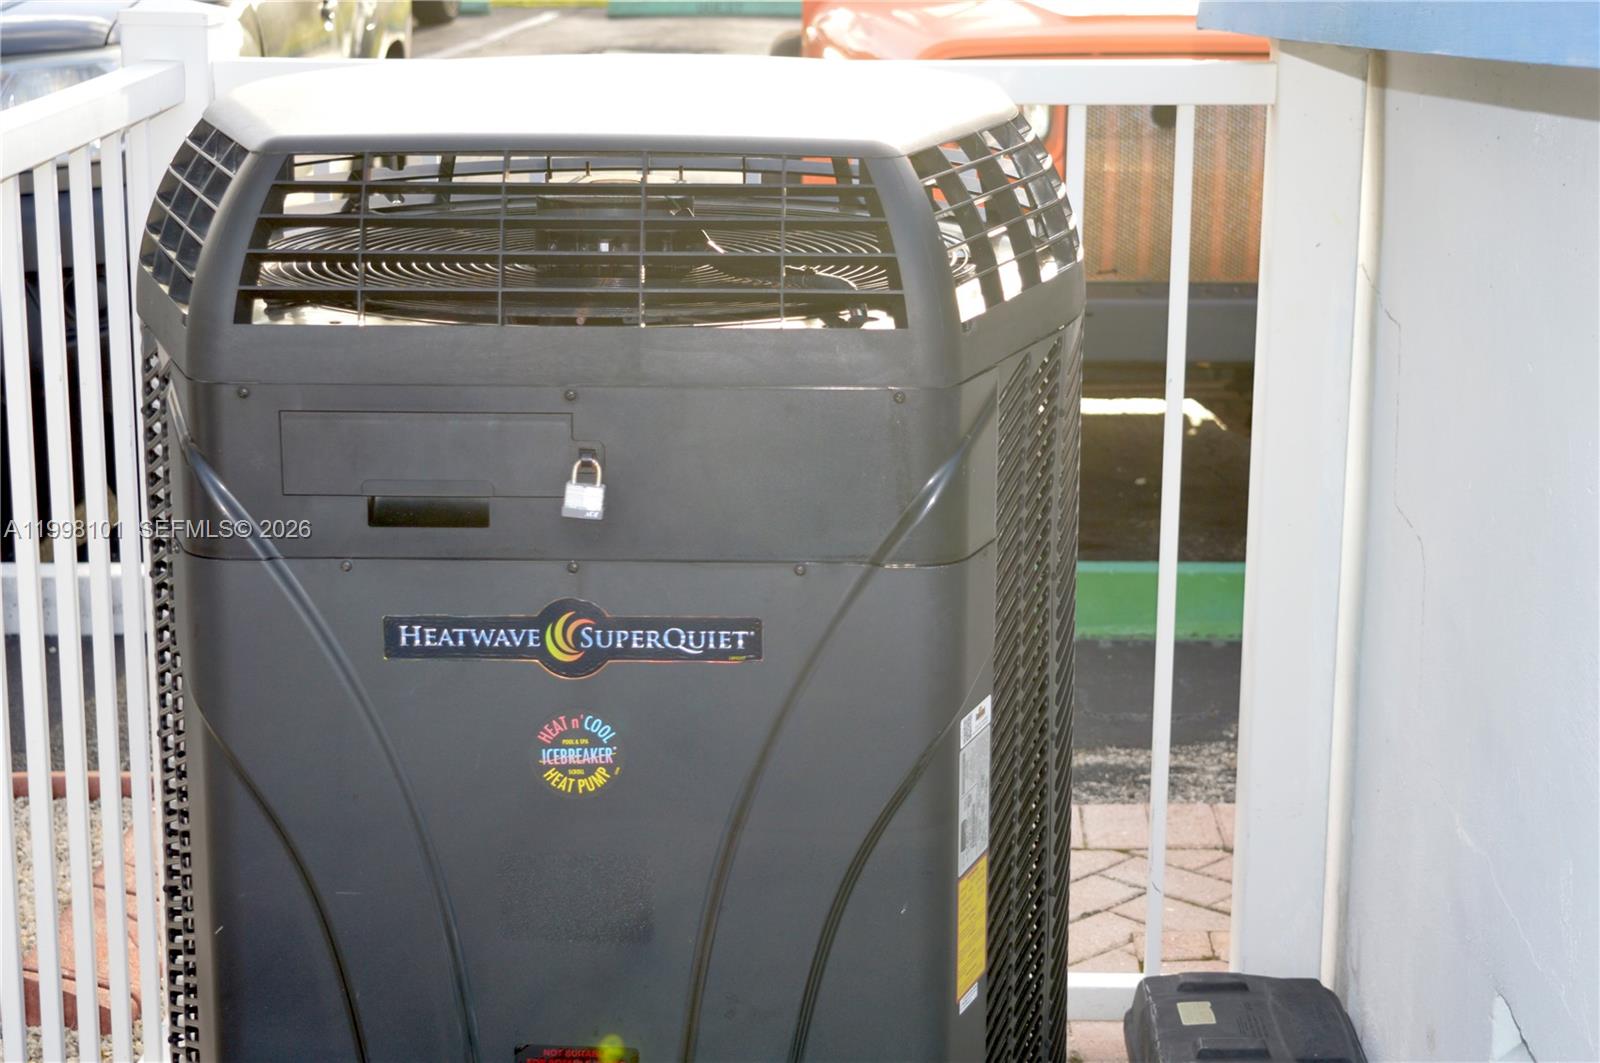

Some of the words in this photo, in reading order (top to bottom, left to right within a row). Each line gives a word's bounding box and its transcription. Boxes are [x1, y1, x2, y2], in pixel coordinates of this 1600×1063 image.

[399, 625, 541, 648] HEATWAVE
[537, 715, 568, 744] HEAT
[584, 715, 616, 744] COOL
[541, 747, 614, 765] ICEBREAKER
[543, 767, 575, 793] HEAT
[577, 766, 611, 794] PUMP
